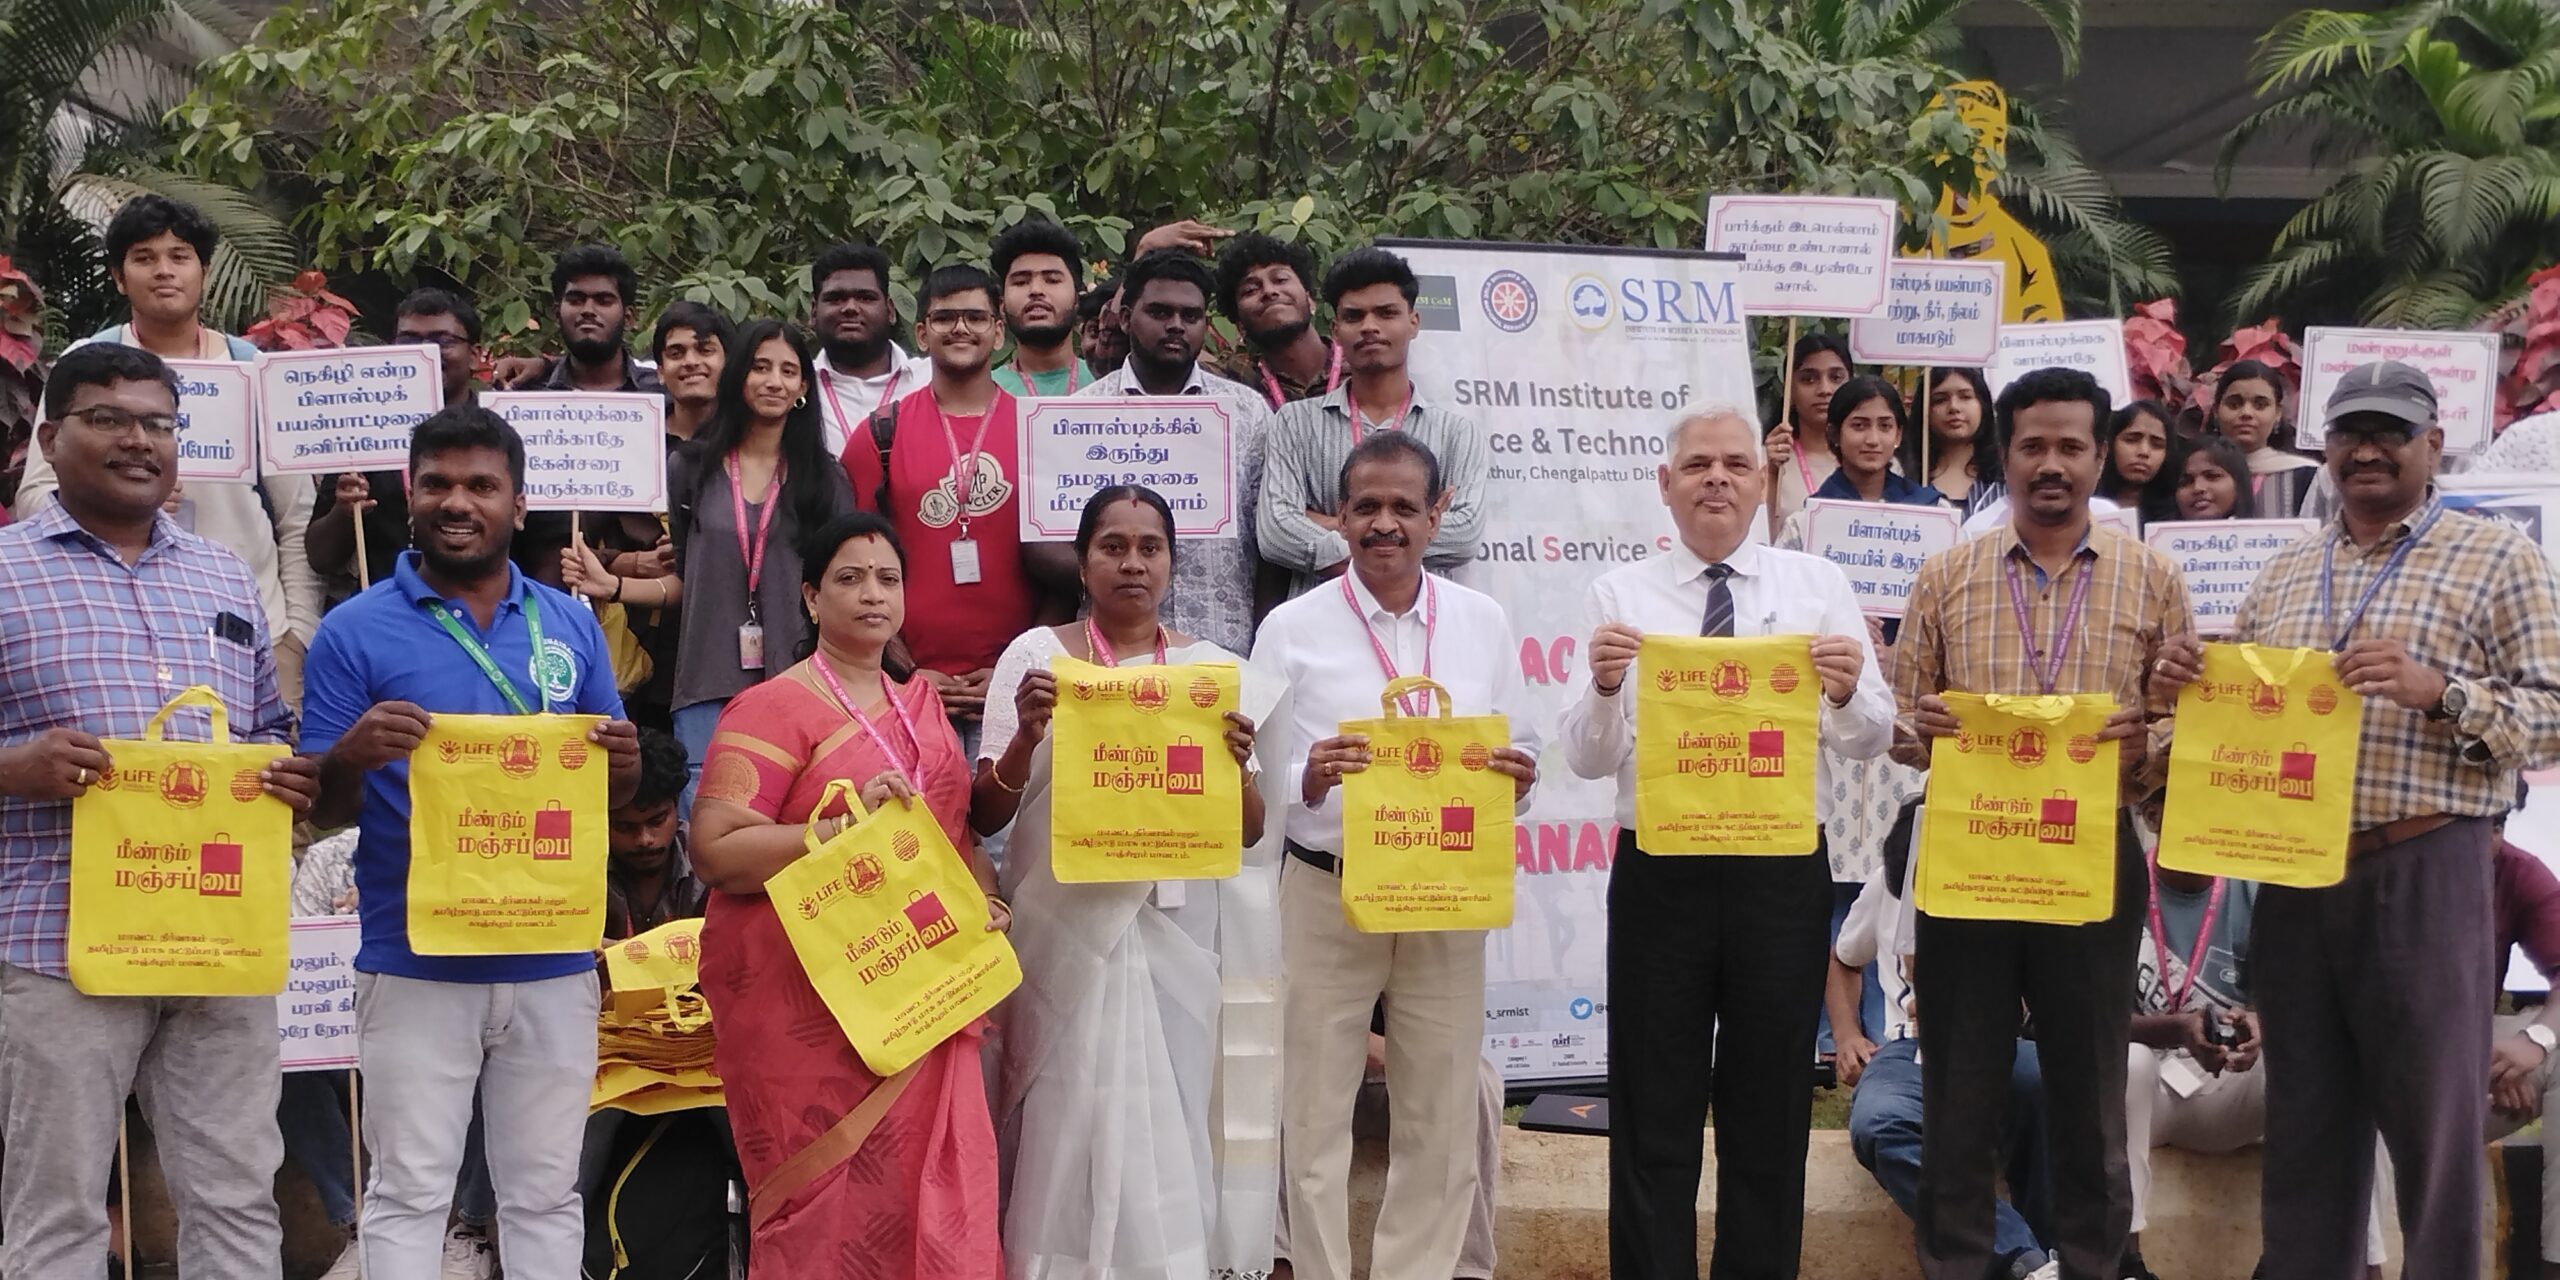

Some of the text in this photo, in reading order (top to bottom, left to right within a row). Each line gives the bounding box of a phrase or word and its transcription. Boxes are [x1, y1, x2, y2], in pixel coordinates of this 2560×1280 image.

[1890, 273, 1931, 295] ாஸ்டிக்
[1621, 278, 1740, 324] SRM
[1888, 302, 1920, 322] ாற்று,
[284, 361, 417, 385] நெகிழி என்ற
[297, 385, 408, 408] பிளாஸ்டிக்
[1454, 379, 1690, 410] SRM Institute of
[1052, 417, 1202, 438] பிளாஸ்டிக்கில்
[1085, 442, 1169, 464] இருந்து
[1489, 428, 1666, 456] ce & Techno
[1489, 465, 1657, 483] thur, Chengalpattu Dis
[1848, 520, 1921, 544] பிளாஸ்டிக்
[1476, 535, 1536, 562] onal
[1542, 536, 1648, 562] Service
[2173, 535, 2238, 552] நெகிழி
[2183, 557, 2261, 573] பிளாஸ்
[1097, 681, 1125, 692] LiFE
[1680, 671, 1707, 682] LiFE
[2219, 683, 2243, 696] LiFE
[464, 743, 494, 755] LiFE
[1678, 730, 1740, 751] மீண்டும்
[1977, 734, 2003, 747] LiFE
[1093, 742, 1158, 765] மீண்டும்
[1376, 746, 1402, 758] LiFE
[2211, 744, 2273, 768] மீண்டும்
[123, 770, 156, 783] LiFE
[1375, 804, 1433, 825] மீண்டும்
[1969, 793, 2033, 815] மீண்டும்
[458, 807, 527, 831] மீண்டும்
[116, 838, 191, 863] மீண்டும்
[1515, 821, 1620, 873] ANA
[815, 879, 843, 903] LiFE
[845, 919, 904, 963] மீண்டும்
[290, 952, 345, 972] டிலும்,
[288, 975, 357, 995] ட்டிலும்,
